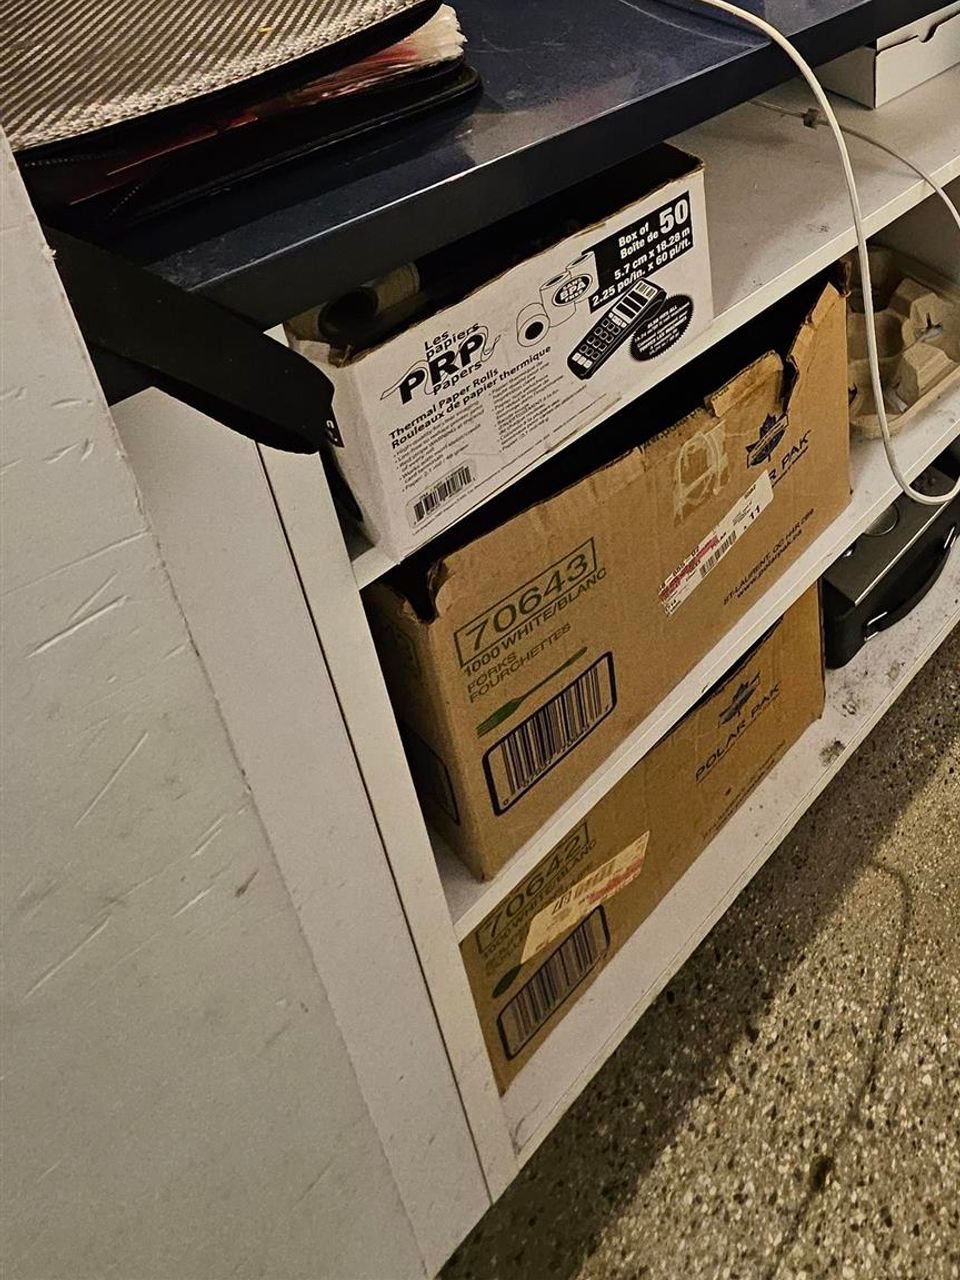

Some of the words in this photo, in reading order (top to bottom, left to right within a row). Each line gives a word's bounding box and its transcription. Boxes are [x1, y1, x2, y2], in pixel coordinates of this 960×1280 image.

[618, 231, 638, 247] Box
[640, 222, 649, 236] of
[659, 199, 689, 234] 50
[647, 231, 659, 243] de
[592, 285, 616, 307] 2.25
[647, 262, 655, 272] x
[655, 252, 668, 266] 60
[614, 263, 631, 280] 5.7
[632, 254, 648, 269] cm
[648, 249, 656, 259] x
[655, 233, 681, 254] 18.28
[681, 227, 690, 238] m
[560, 282, 586, 301] BPA
[425, 331, 449, 351] Les
[426, 323, 480, 362] papiers
[399, 334, 484, 405] PRP
[388, 405, 437, 440] Thermal
[439, 386, 470, 408] Paper
[472, 368, 499, 387] Rolls
[391, 411, 445, 449] Rouleaux
[446, 401, 460, 414] de
[463, 380, 497, 405] papier
[499, 346, 551, 382] thermique
[782, 430, 811, 470] PAK
[463, 646, 500, 677] 1000
[501, 567, 607, 649] WHITE/BLANC
[465, 554, 588, 651] 70643
[467, 652, 517, 694] FORKS
[470, 623, 571, 703] FOURCHETTES
[695, 720, 746, 782] POLAR
[751, 681, 780, 718] PAK
[484, 834, 582, 938] 70642
